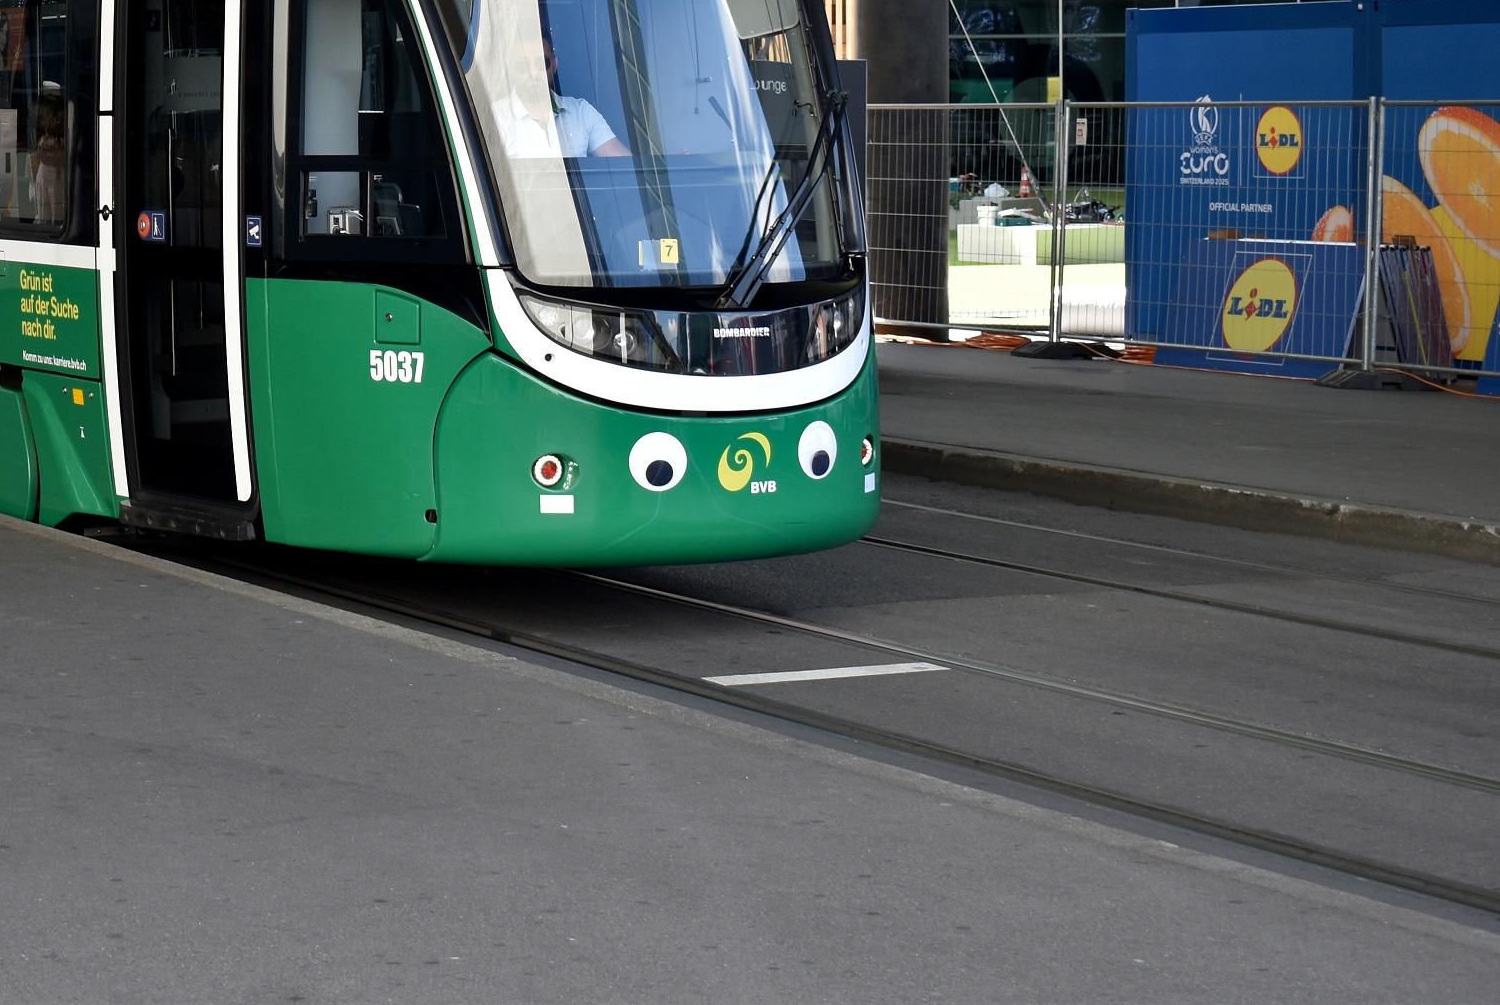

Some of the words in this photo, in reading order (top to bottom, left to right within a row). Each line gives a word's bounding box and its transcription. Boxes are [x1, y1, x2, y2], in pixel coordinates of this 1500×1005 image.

[1209, 202, 1240, 212] OFFICIAL
[1240, 203, 1273, 213] PARTNER
[664, 245, 674, 257] 7
[20, 269, 41, 291] Grün
[42, 271, 53, 293] ist
[20, 294, 34, 313] auf
[35, 295, 49, 315] der
[50, 296, 79, 320] Suche
[21, 317, 42, 338] nach
[43, 319, 57, 340] dir.
[713, 327, 770, 338] BOMBARDIER
[22, 349, 37, 363] Komm
[370, 350, 424, 383] 5037
[750, 481, 777, 494] BVB
